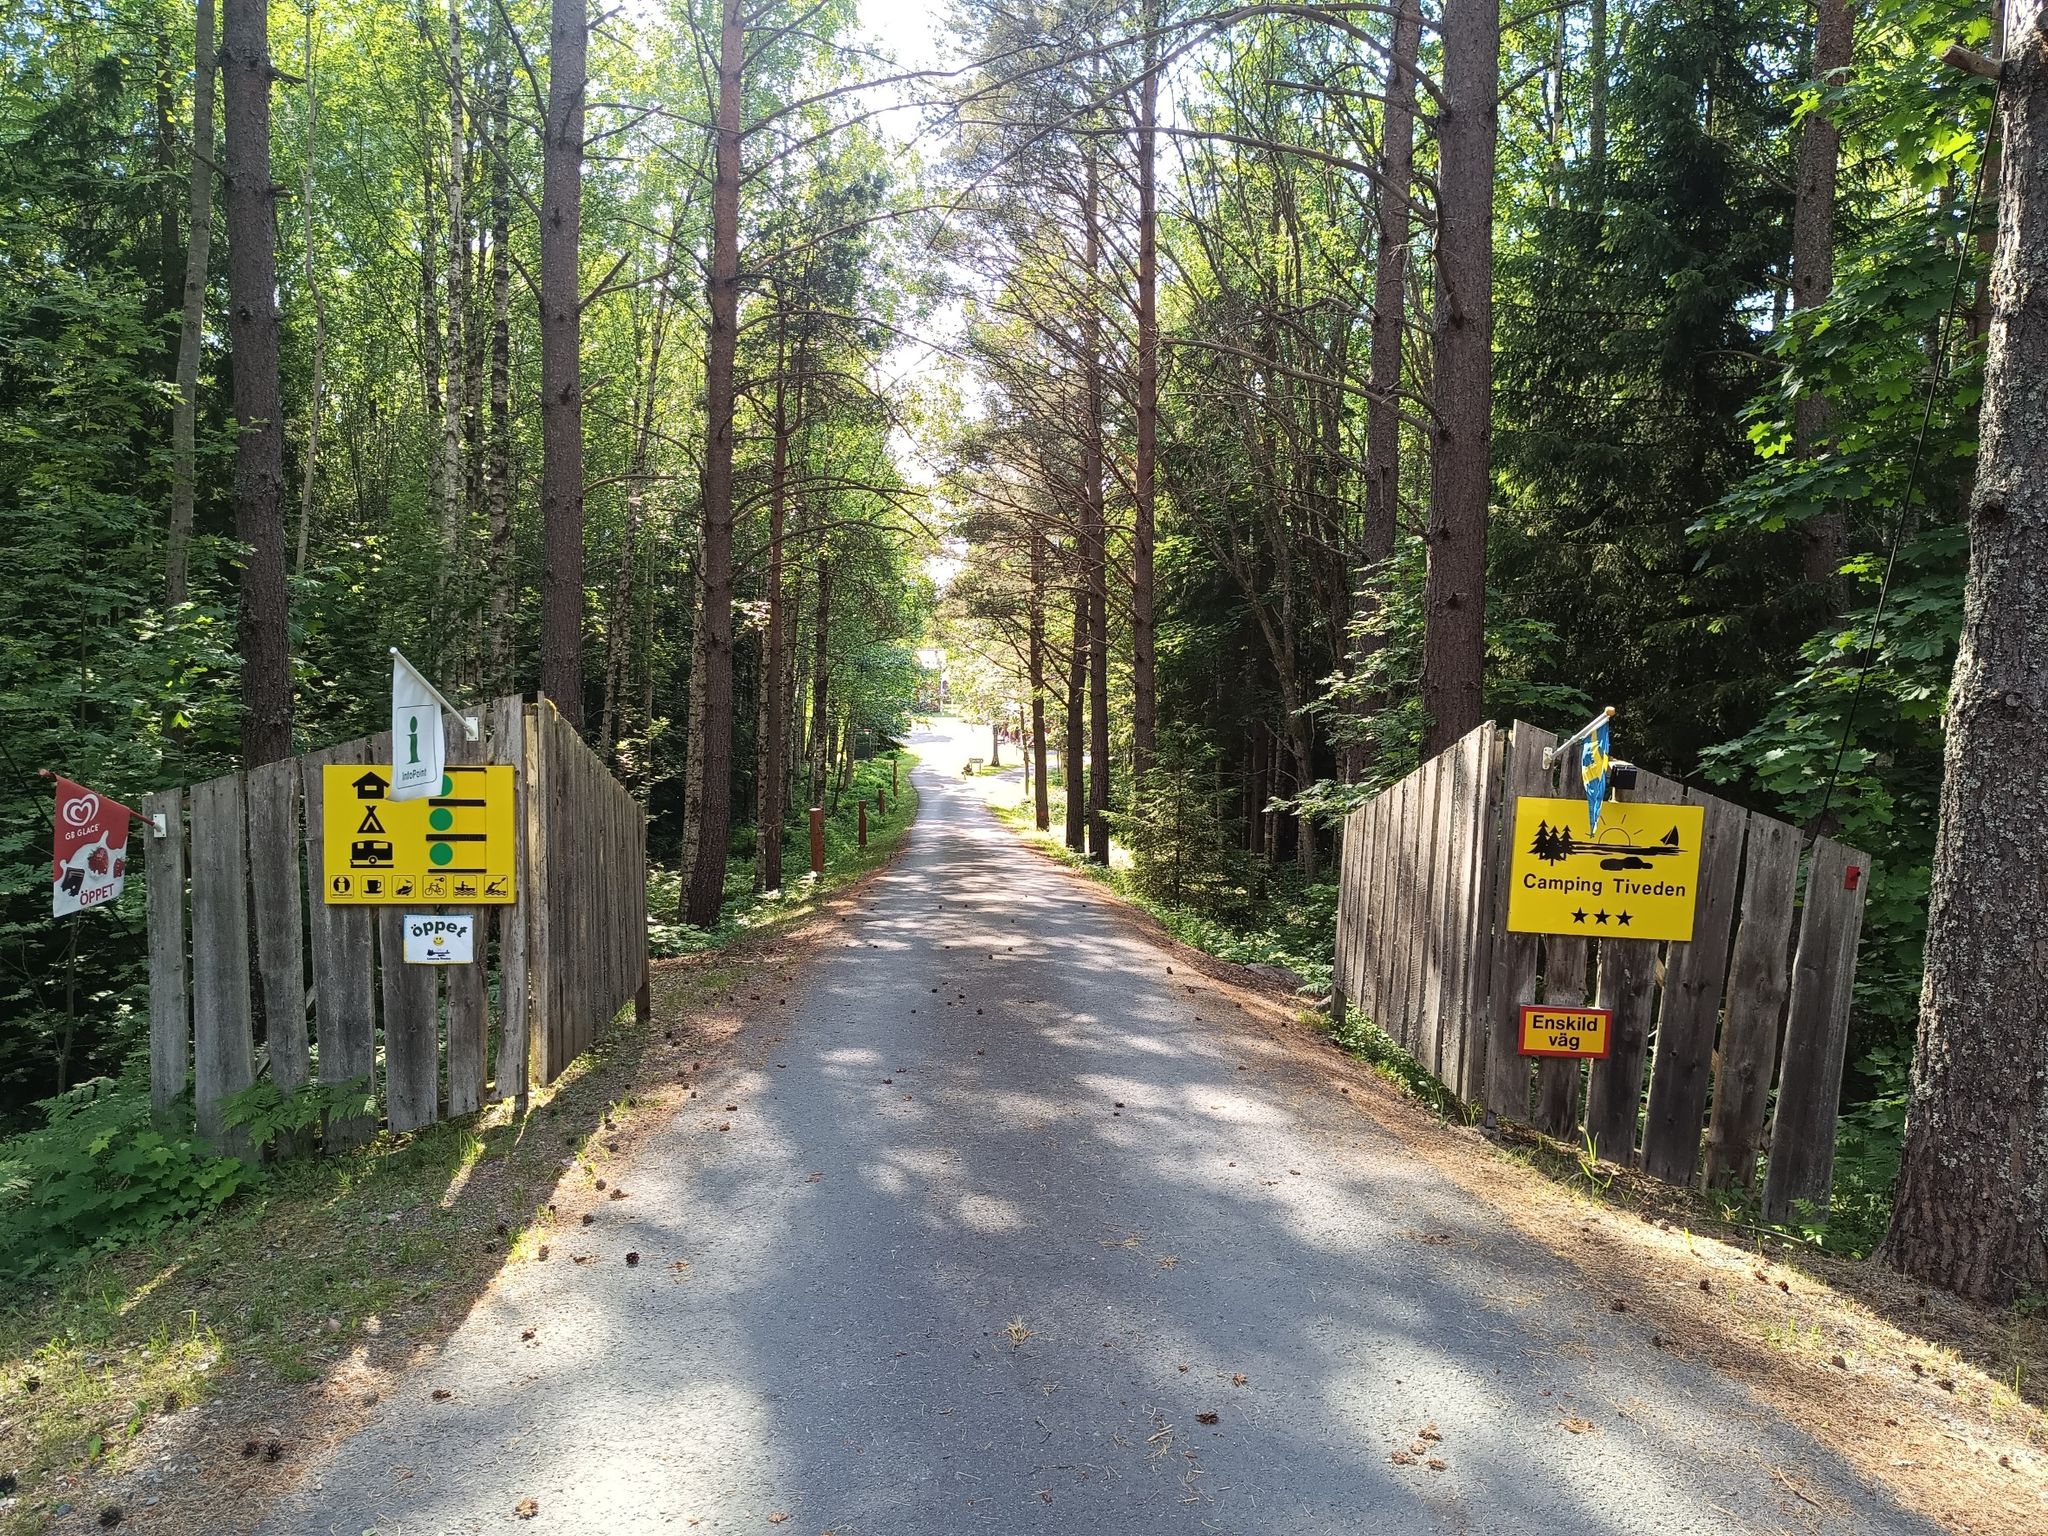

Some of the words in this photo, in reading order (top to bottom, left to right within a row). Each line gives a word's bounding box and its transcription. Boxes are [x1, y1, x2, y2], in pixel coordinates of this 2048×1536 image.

[65, 831, 75, 840] GB
[77, 824, 99, 837] GLACE
[80, 883, 115, 905] ÖPPET
[1523, 873, 1603, 896] Camping
[1613, 878, 1686, 897] Tiveden
[410, 921, 468, 938] öppet
[1532, 1014, 1598, 1032] Enskild
[1548, 1032, 1580, 1051] väg
